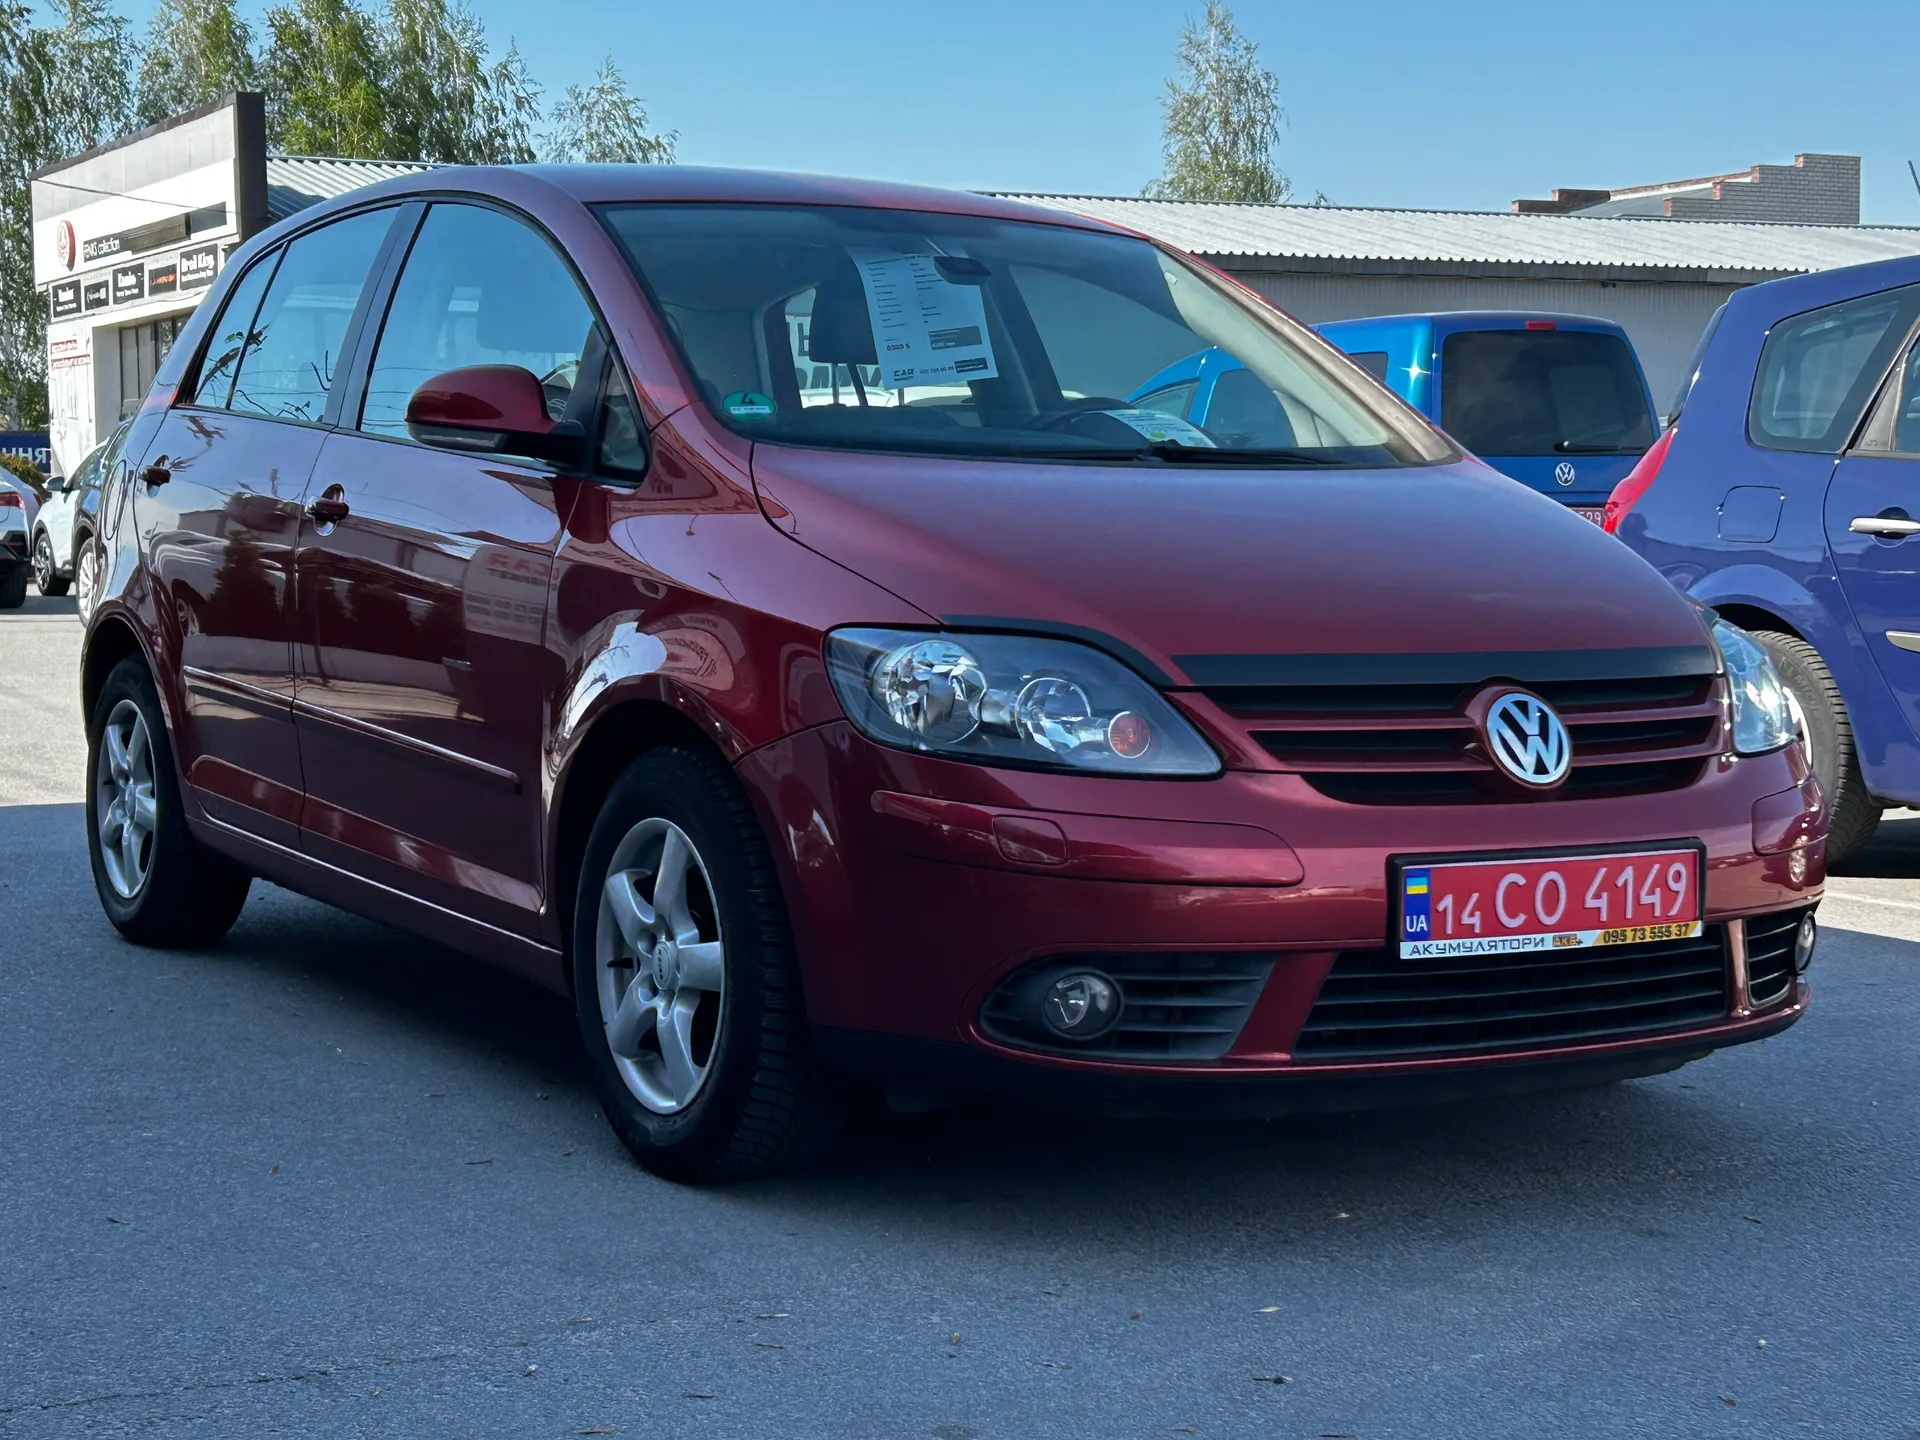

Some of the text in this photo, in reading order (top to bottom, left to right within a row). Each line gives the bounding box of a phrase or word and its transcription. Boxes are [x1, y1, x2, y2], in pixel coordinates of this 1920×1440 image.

[741, 392, 756, 406] 4
[1487, 693, 1570, 784] VW
[1435, 861, 1688, 935] 14 CO 4149
[1405, 913, 1428, 933] UA
[1408, 936, 1546, 957] АКУМУЛЯТОРИ
[1603, 929, 1628, 944] 095
[1630, 927, 1647, 942] 73
[1649, 924, 1673, 940] 555
[1674, 922, 1690, 937] 37
